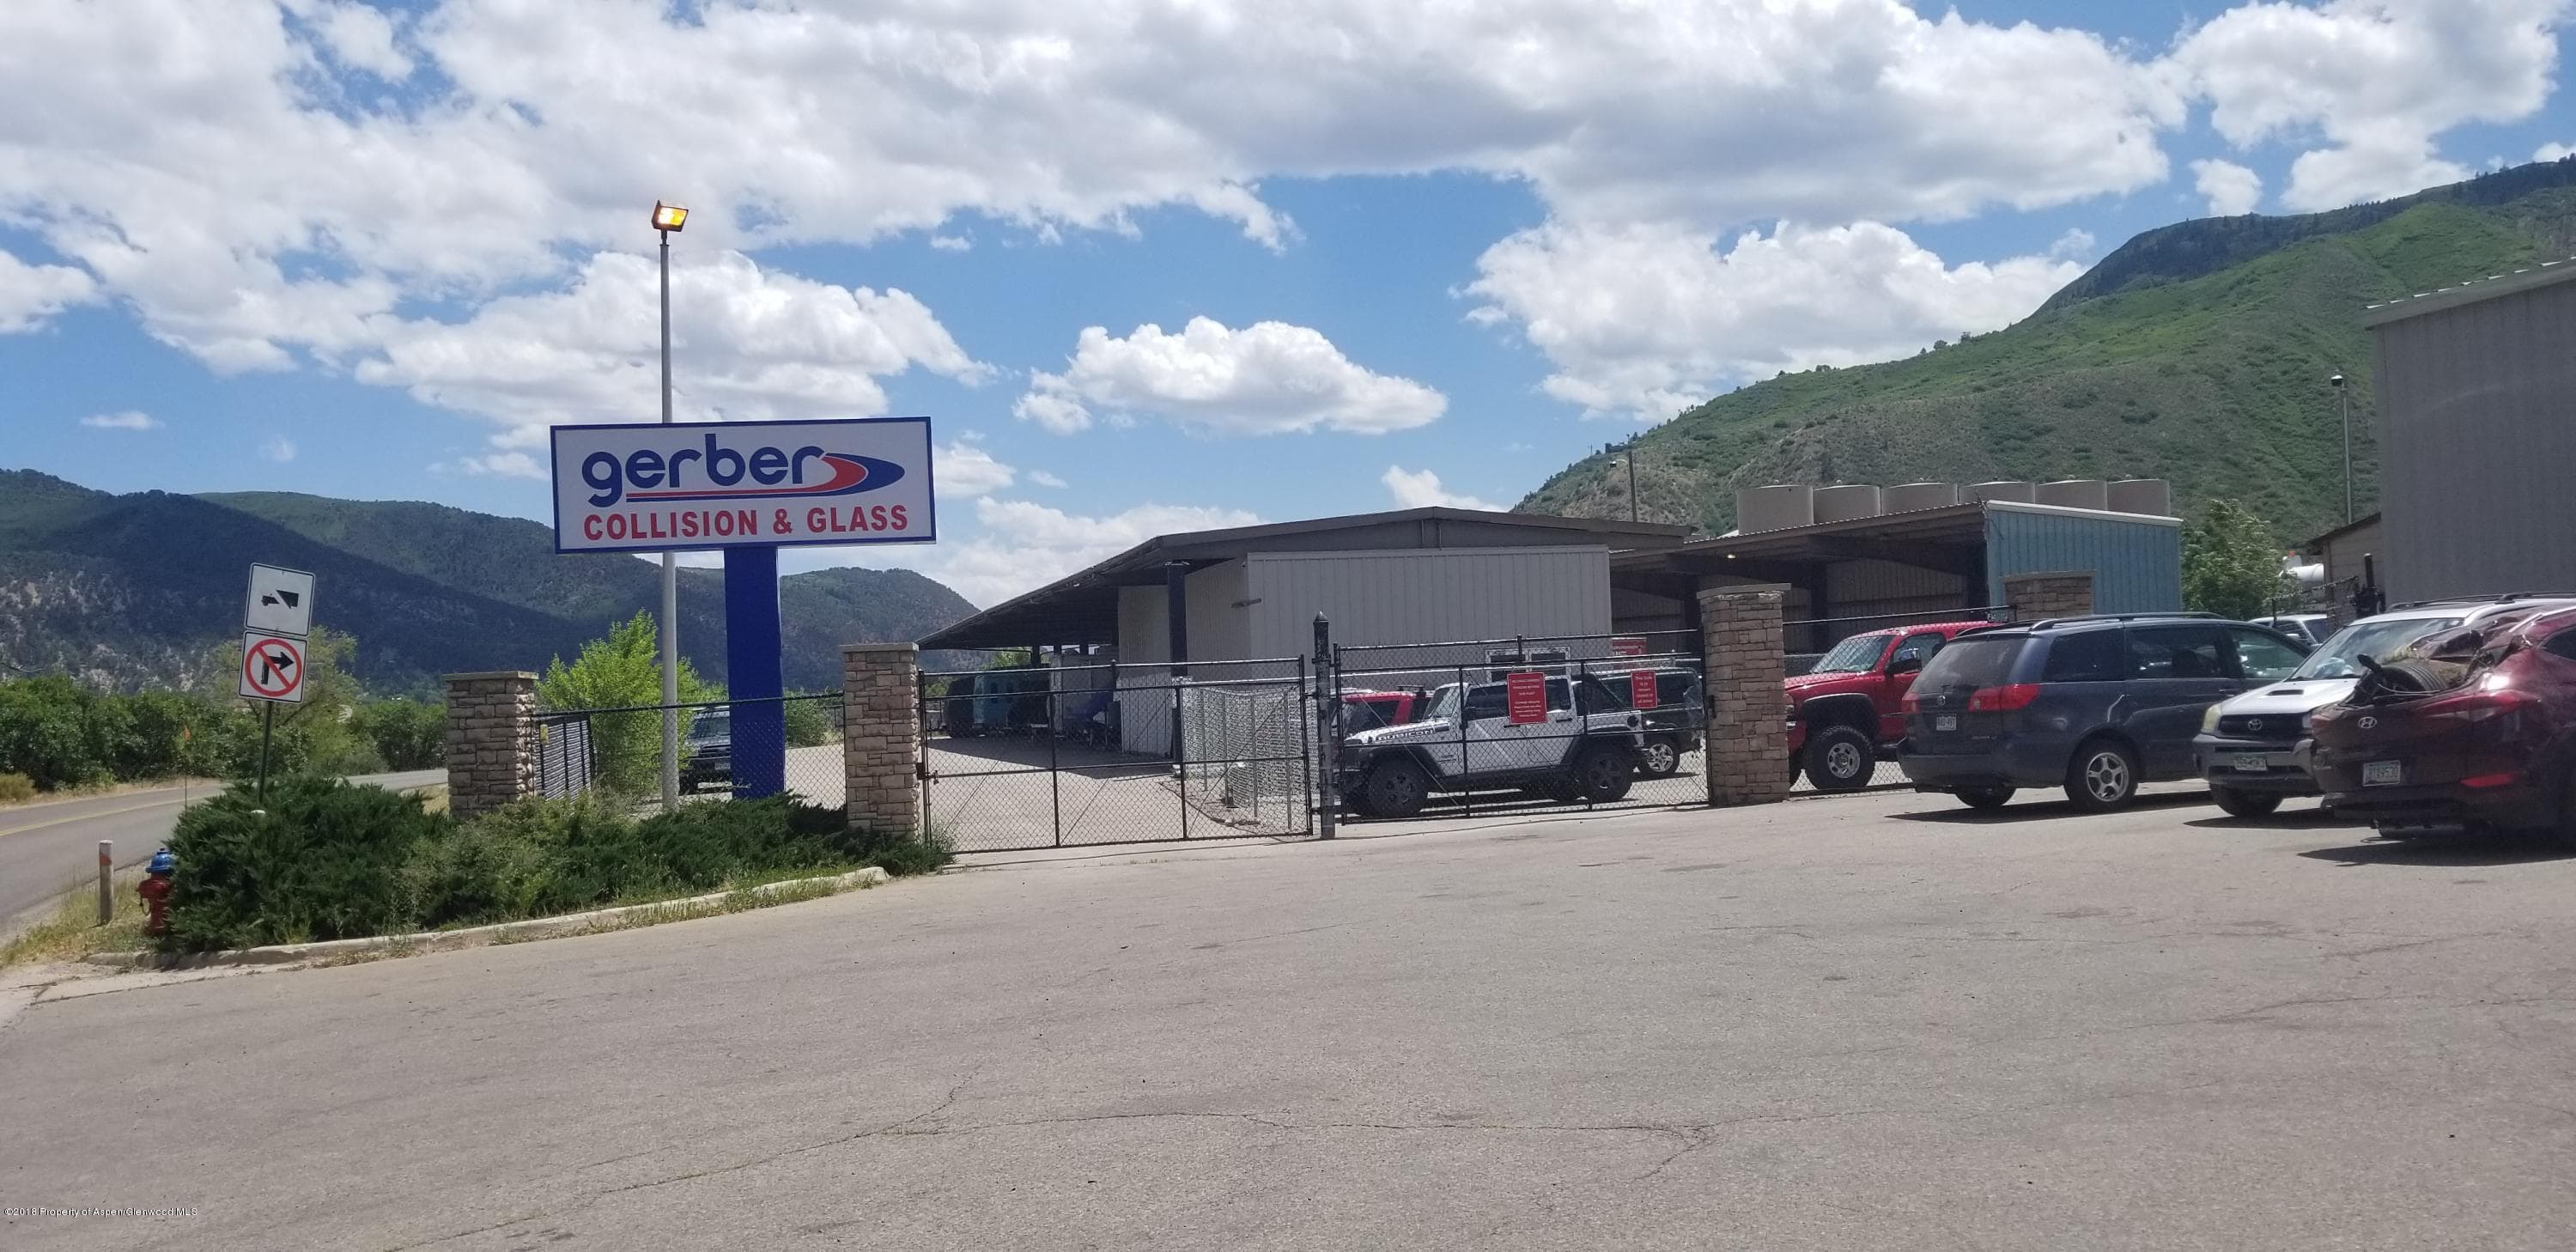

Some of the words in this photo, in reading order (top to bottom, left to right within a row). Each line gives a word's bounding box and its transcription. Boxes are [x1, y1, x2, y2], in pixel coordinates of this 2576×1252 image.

[581, 433, 825, 508] gerber
[583, 508, 758, 541] COLLISION
[772, 508, 793, 534] &
[806, 503, 908, 532] GLASS
